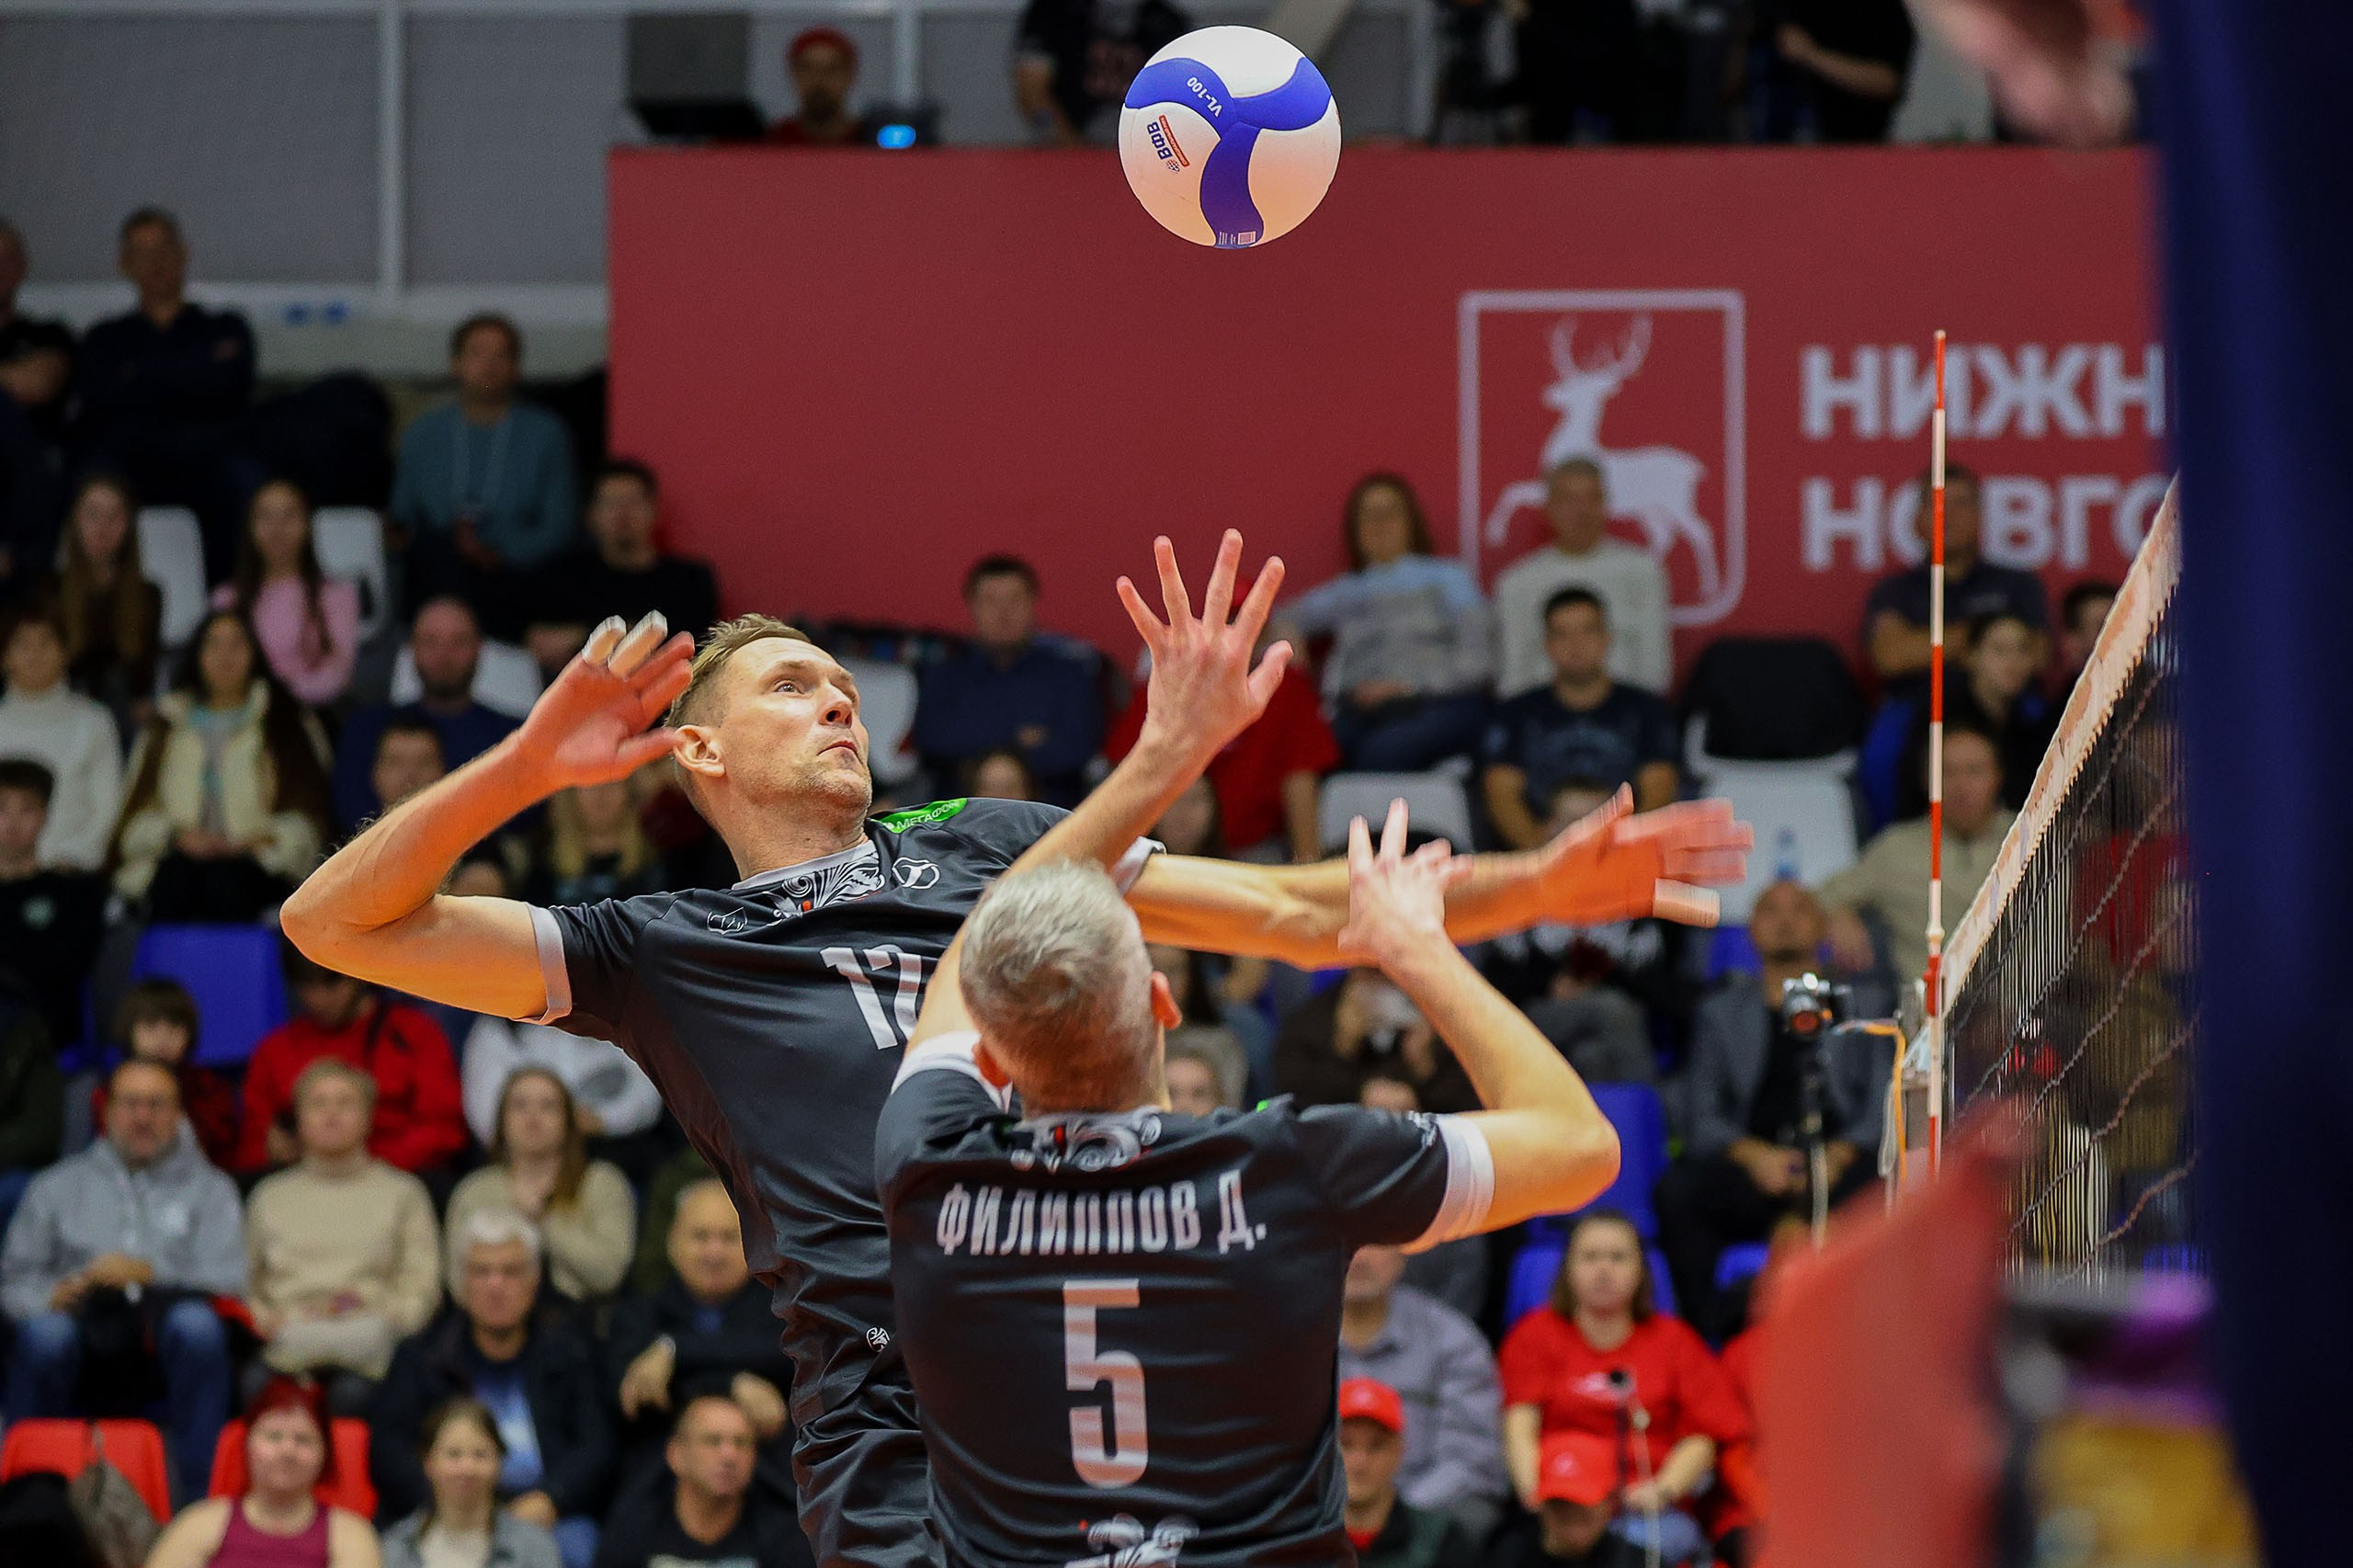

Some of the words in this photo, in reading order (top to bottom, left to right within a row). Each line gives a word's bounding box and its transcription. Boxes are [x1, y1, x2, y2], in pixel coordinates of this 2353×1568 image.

[1187, 76, 1222, 118] VL-100
[1147, 121, 1173, 160] ВФВ
[1802, 344, 2166, 440] НИЖН
[895, 801, 961, 829] МЕГАФОН
[937, 1181, 1201, 1256] ФИЛИППОВ
[1216, 1168, 1267, 1255] Д.
[1063, 1278, 1148, 1489] 5
